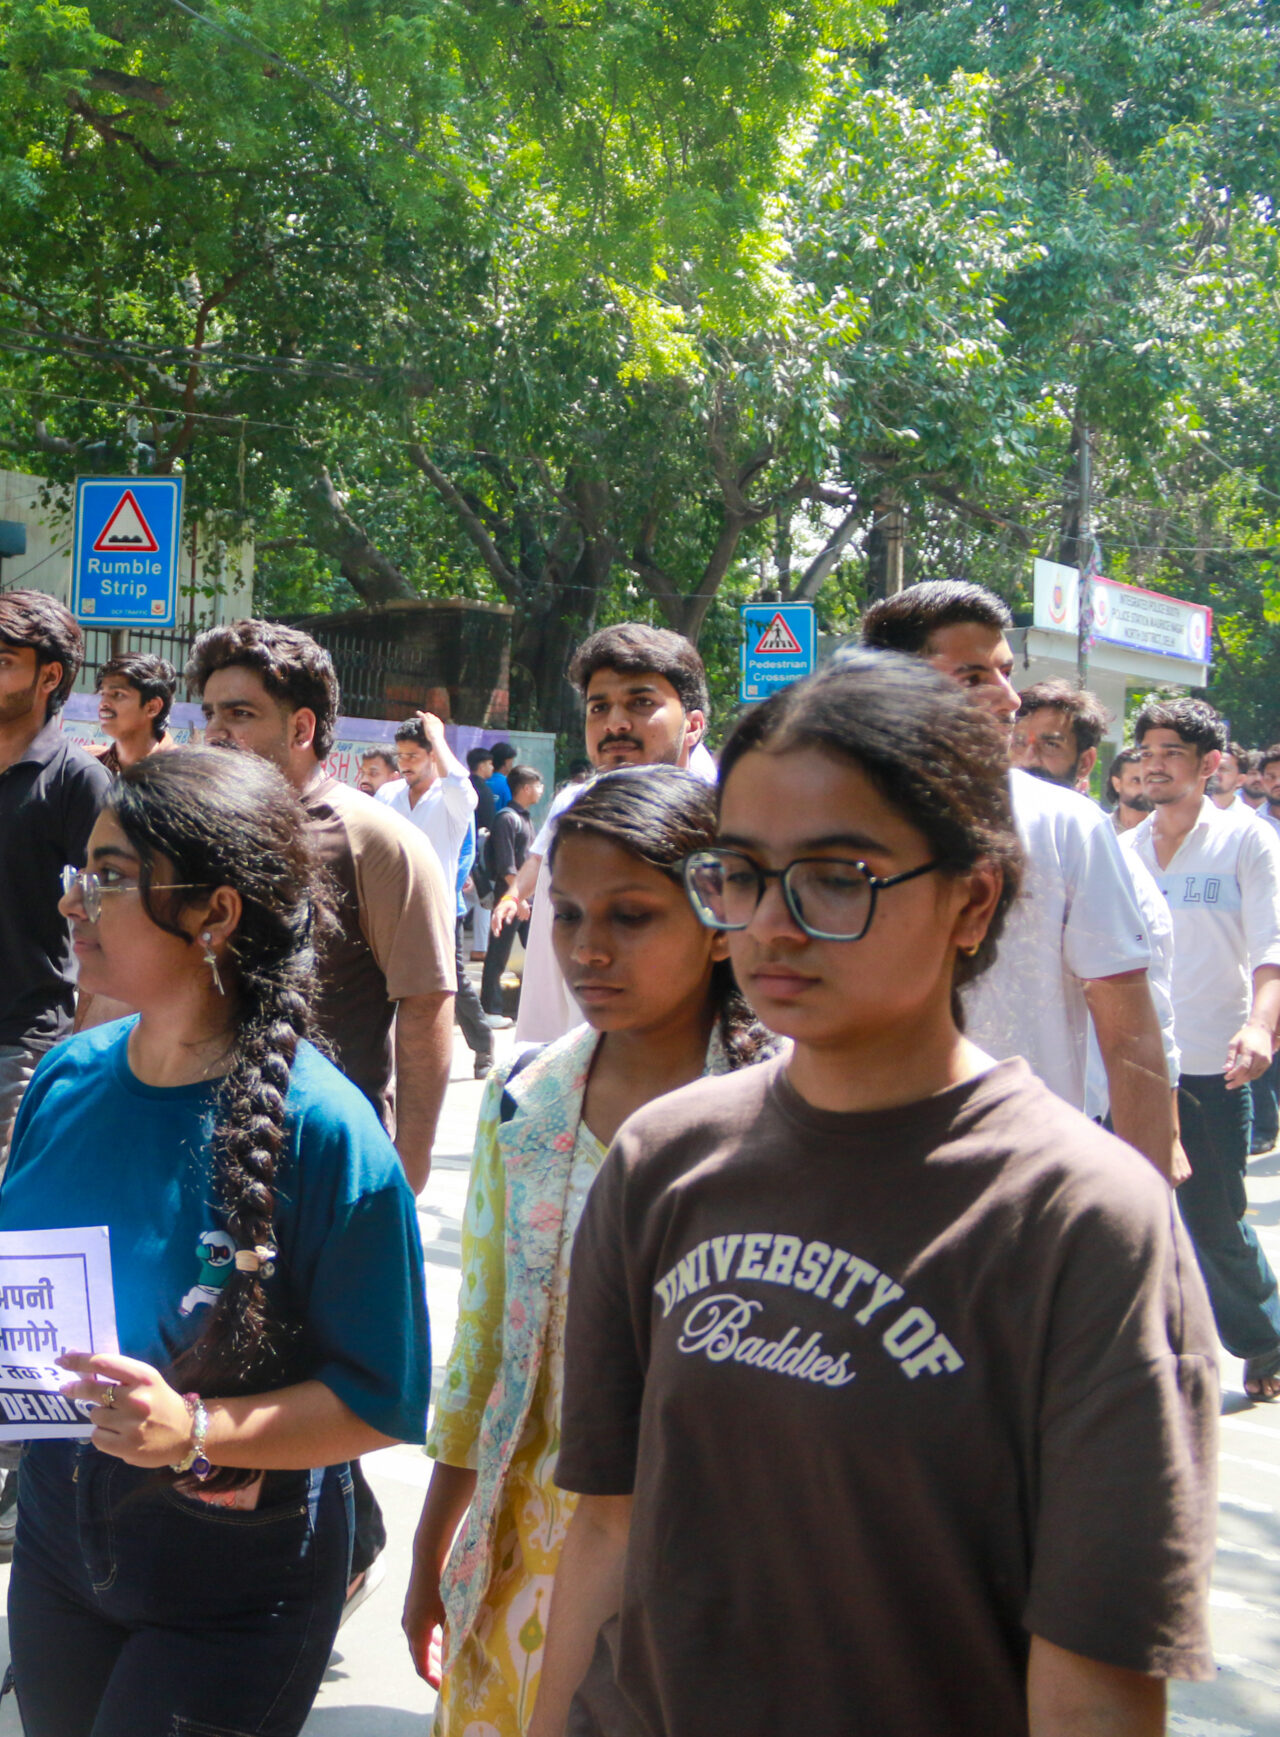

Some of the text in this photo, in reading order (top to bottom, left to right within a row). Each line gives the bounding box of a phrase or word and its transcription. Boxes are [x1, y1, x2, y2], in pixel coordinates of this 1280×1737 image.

[88, 558, 162, 575] Rumble
[101, 579, 148, 599] Strip
[749, 660, 807, 668] Pedestrian
[174, 731, 190, 743] AB
[653, 1232, 965, 1380] UNIVERSITY OF
[677, 1293, 856, 1387] Baddies
[2, 1363, 43, 1380] तक
[45, 1365, 60, 1381] ?
